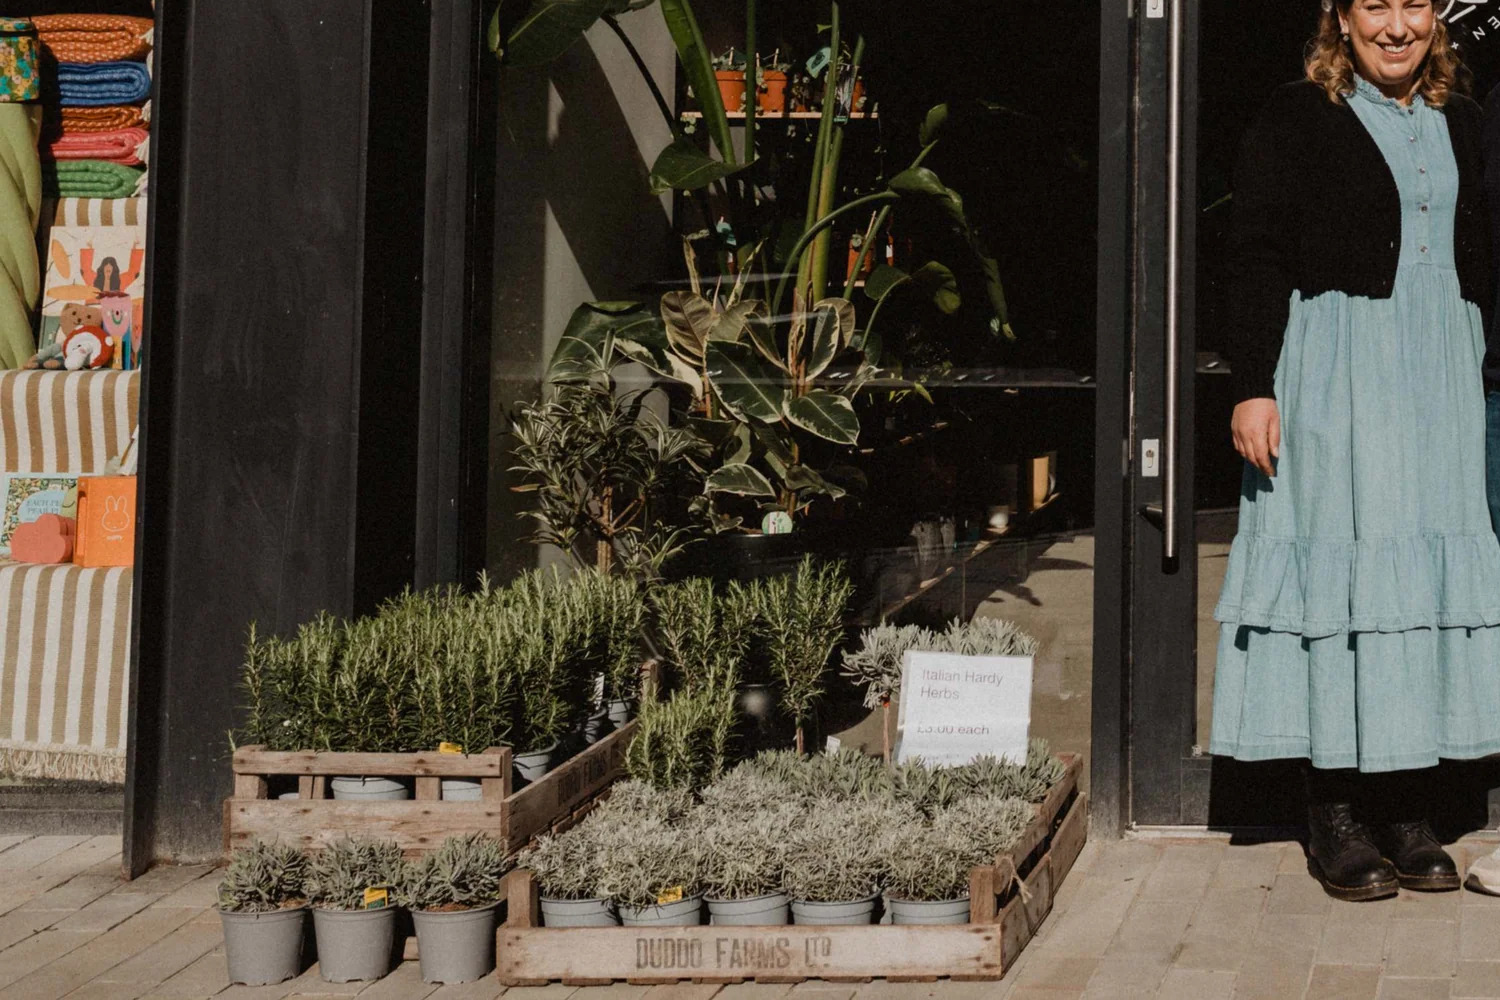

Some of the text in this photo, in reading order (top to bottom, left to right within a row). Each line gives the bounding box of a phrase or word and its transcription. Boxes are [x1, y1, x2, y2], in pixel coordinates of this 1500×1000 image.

[922, 668, 1004, 687] Italian Hardy
[920, 686, 960, 700] Herbs
[957, 724, 990, 735] each
[715, 937, 790, 969] FARMS
